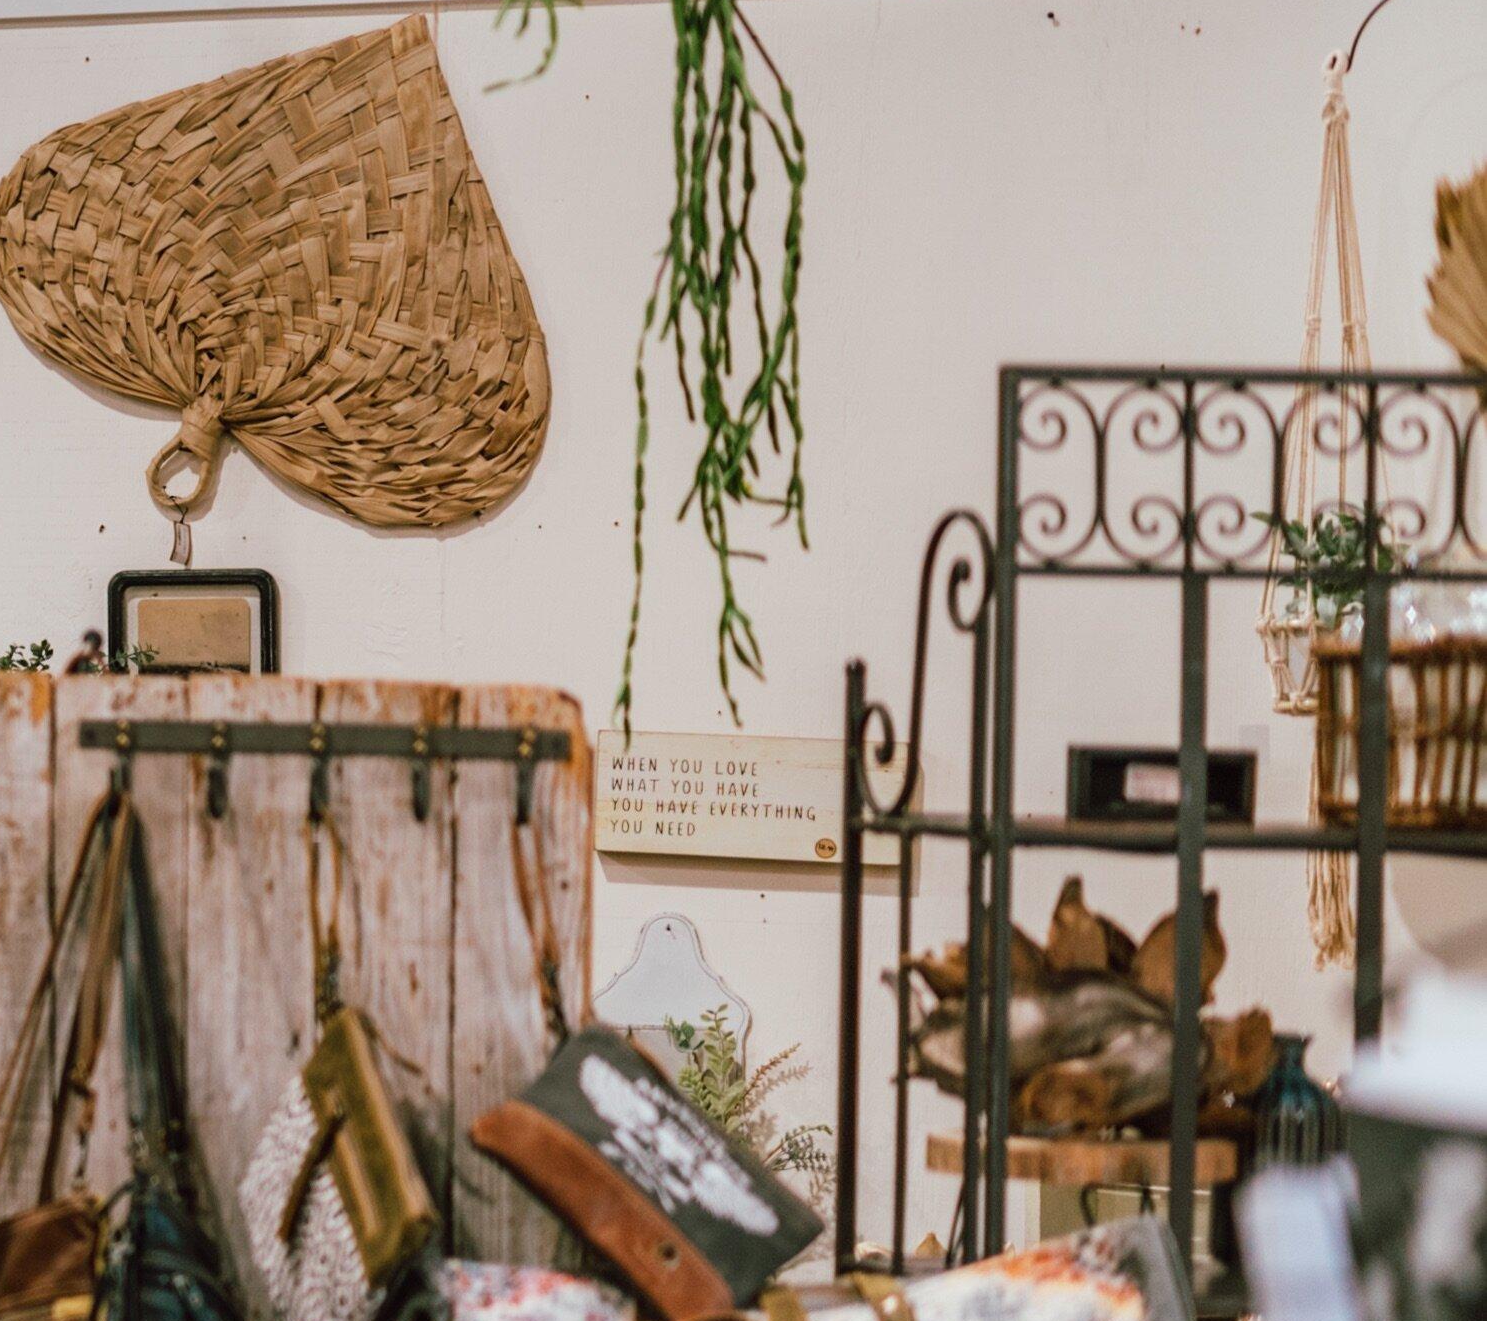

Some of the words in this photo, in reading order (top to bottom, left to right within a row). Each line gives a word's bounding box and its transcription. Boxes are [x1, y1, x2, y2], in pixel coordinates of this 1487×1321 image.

[612, 755, 658, 773] WHEN
[670, 758, 703, 775] YOU
[715, 761, 758, 777] LOVE
[611, 777, 659, 793] WHAT
[672, 779, 704, 795] YOU
[716, 782, 759, 798] HAVE
[611, 797, 644, 813] YOU
[656, 799, 698, 816] HAVE
[710, 801, 817, 822] EVERYTHING
[610, 818, 643, 835] YOU
[655, 821, 697, 837] NEED
